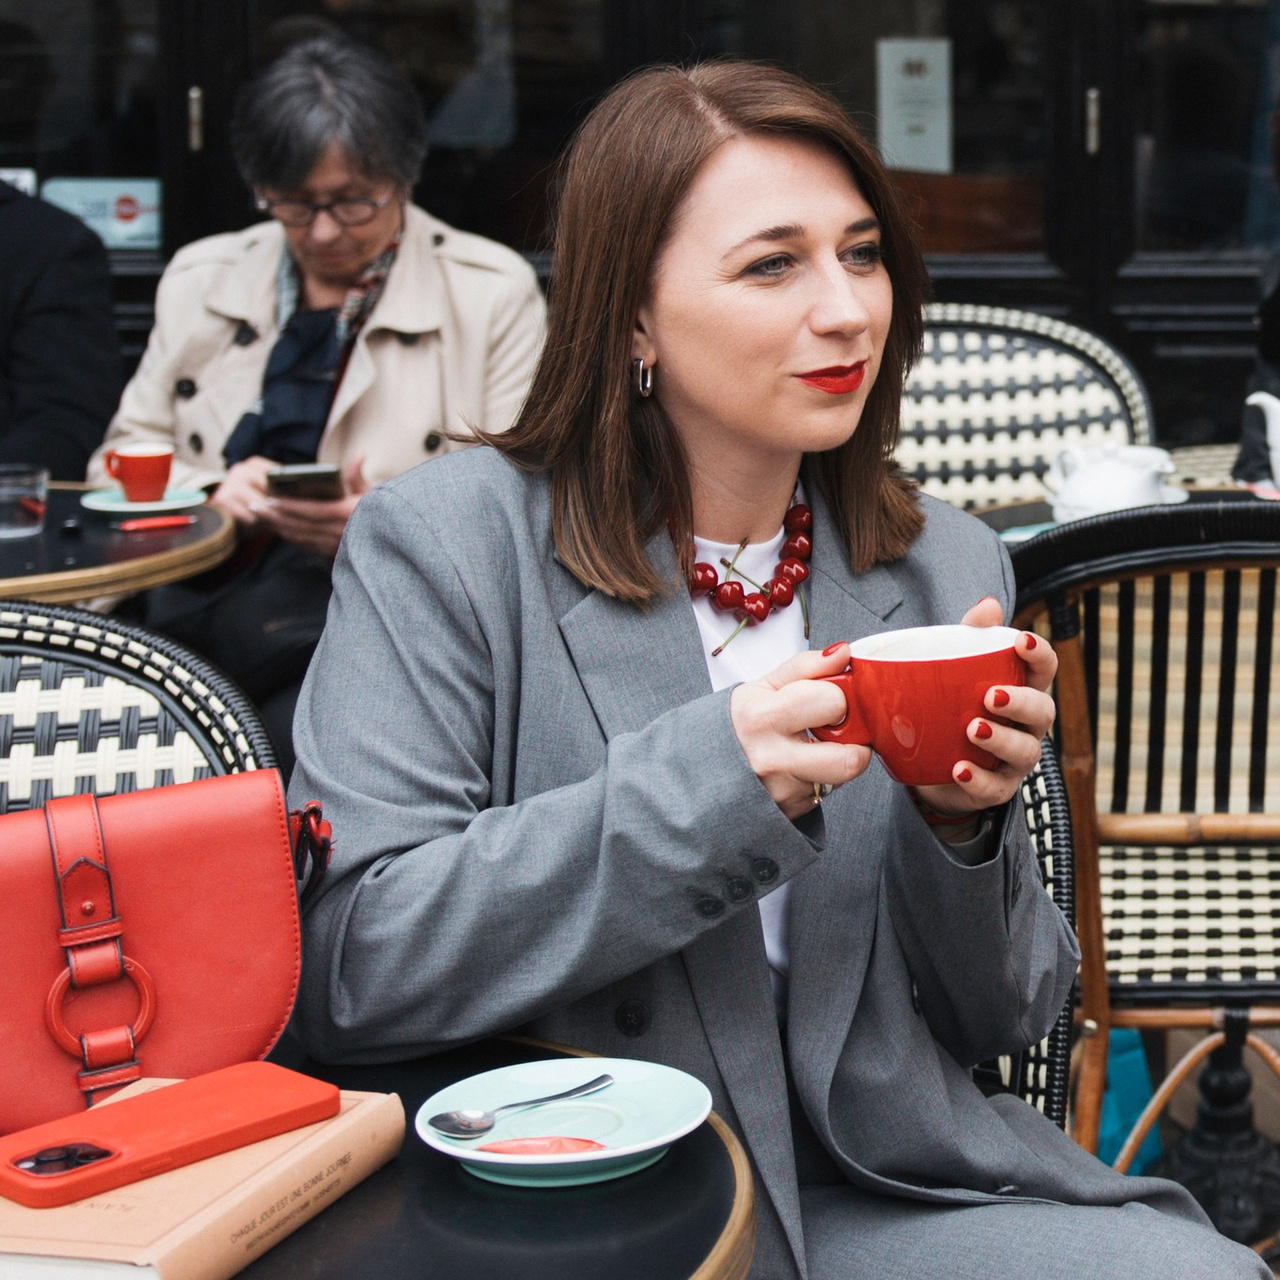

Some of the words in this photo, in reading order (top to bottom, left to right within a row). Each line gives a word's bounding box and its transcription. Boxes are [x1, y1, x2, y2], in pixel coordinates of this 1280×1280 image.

[231, 1220, 257, 1244] CHAQUE
[260, 1206, 276, 1224] JOUR
[277, 1196, 288, 1212] EST
[290, 1186, 303, 1202] UNE
